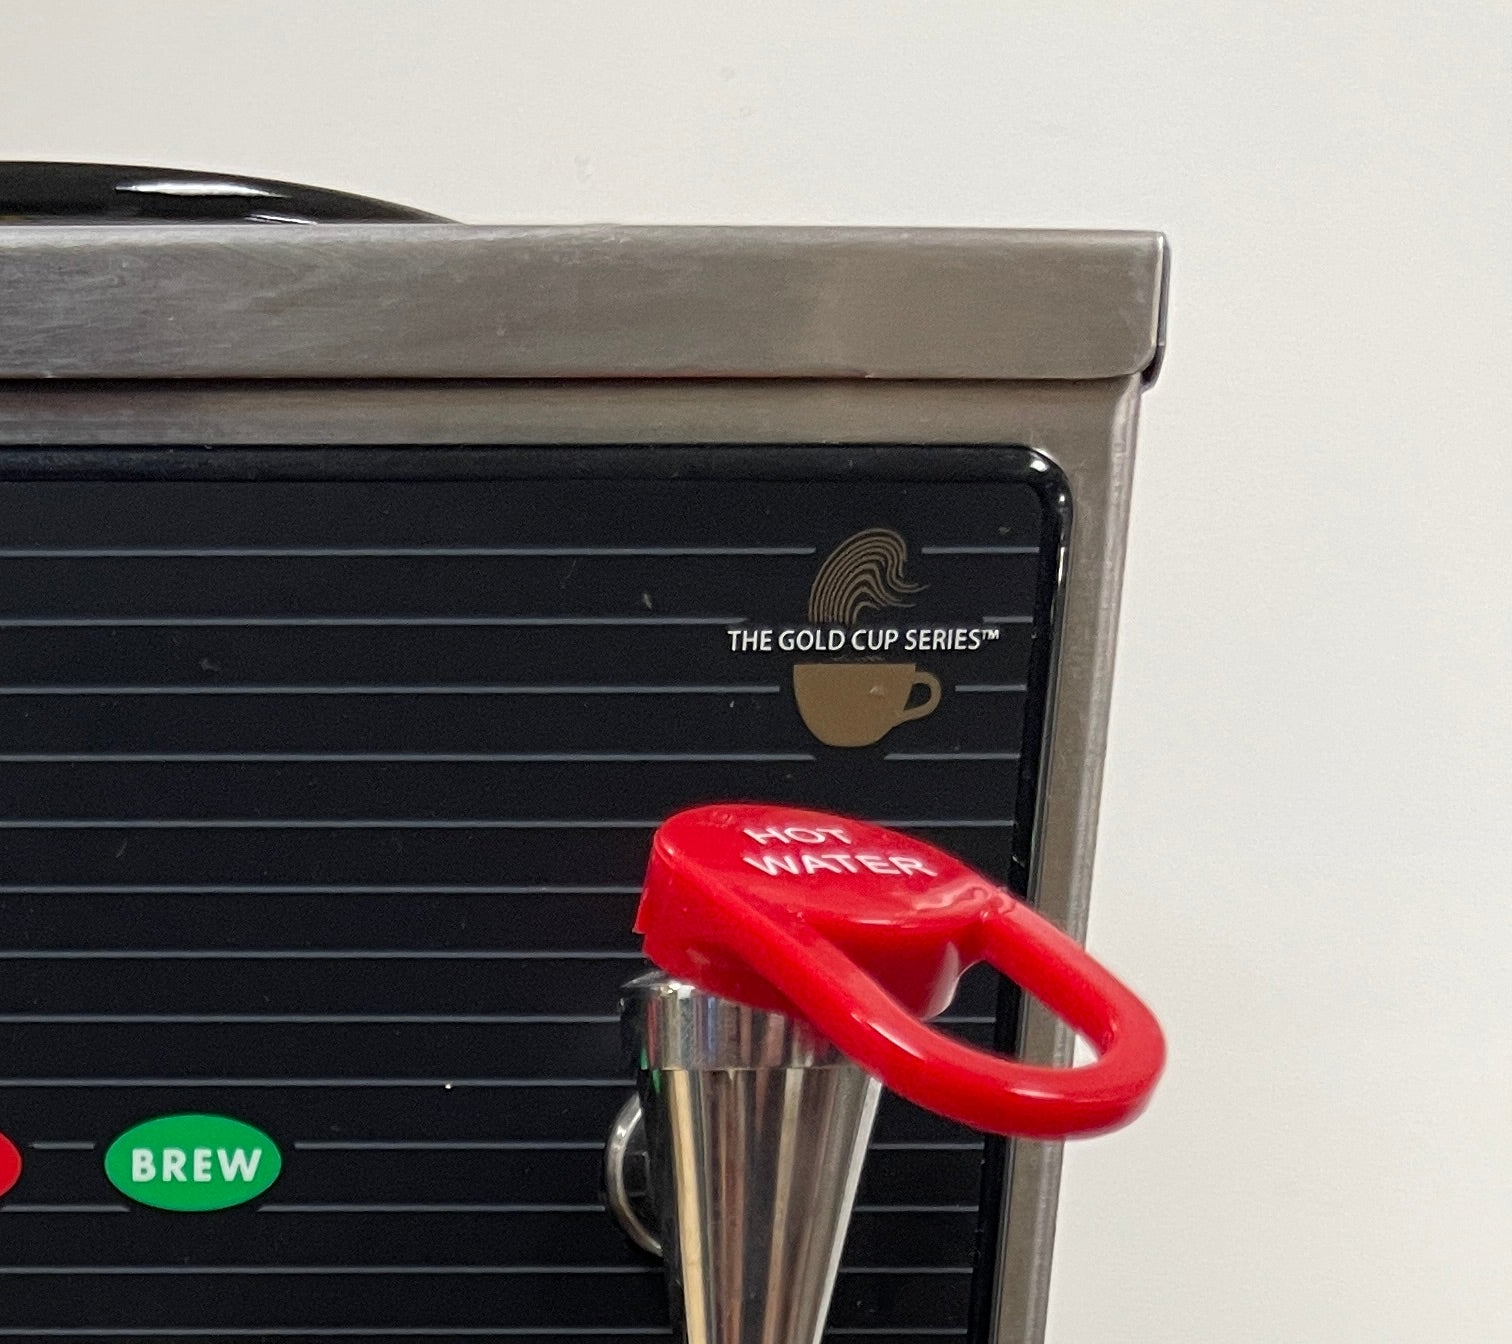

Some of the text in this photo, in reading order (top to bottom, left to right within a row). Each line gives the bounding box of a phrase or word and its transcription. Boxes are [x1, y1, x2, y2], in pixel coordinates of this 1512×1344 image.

[728, 630, 772, 651] THE
[778, 630, 846, 651] GOLD
[852, 630, 898, 651] CUP
[744, 827, 853, 846] HOT
[743, 854, 938, 877] WATER
[131, 1148, 262, 1182] BREW
